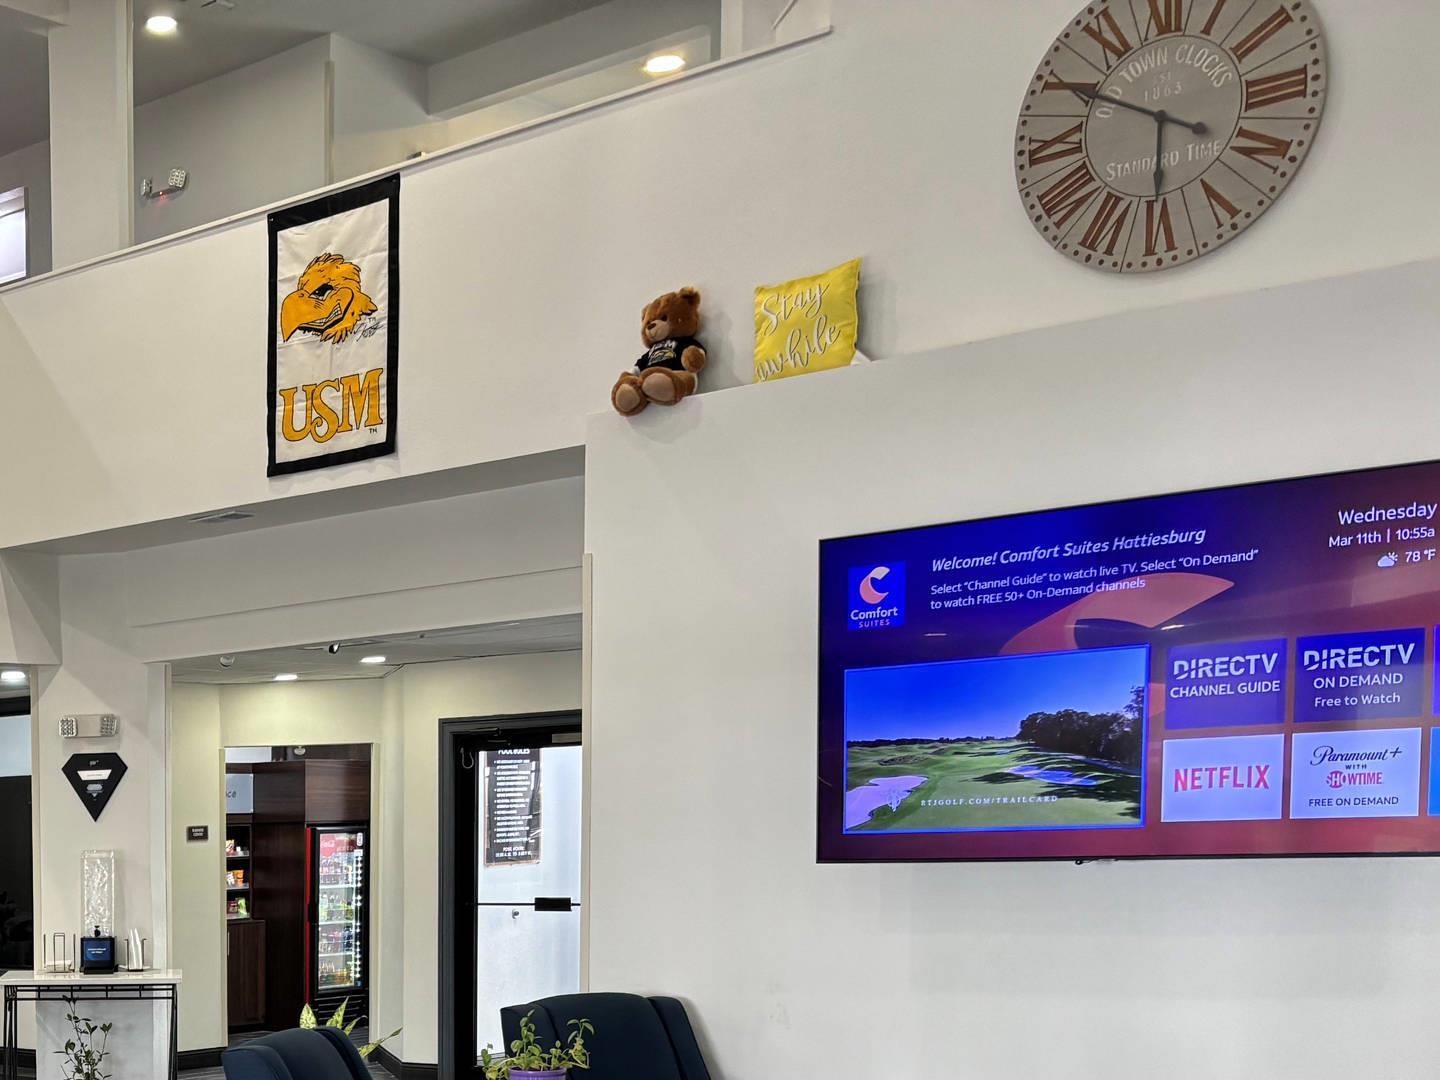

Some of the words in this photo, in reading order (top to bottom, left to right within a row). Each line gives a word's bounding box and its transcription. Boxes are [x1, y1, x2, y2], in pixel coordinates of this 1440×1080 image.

[1119, 46, 1168, 82] TOWN
[1175, 44, 1232, 88] CLOCKS
[1187, 140, 1220, 161] TIME
[761, 281, 830, 336] Stay
[278, 367, 384, 444] USM
[1338, 501, 1438, 525] Wednesday
[1328, 535, 1353, 548] Mar
[1356, 531, 1382, 545] 11th
[1395, 526, 1435, 540] 10:55a
[932, 552, 998, 572] Welcome!
[1000, 544, 1060, 564] Comfort
[1062, 541, 1109, 557] Suites
[1112, 528, 1206, 550] Hattiesburg
[1405, 550, 1421, 563] 78
[931, 583, 962, 595] Select
[1049, 572, 1061, 582] to
[1063, 566, 1097, 581] watch
[1099, 564, 1119, 576] live
[1121, 562, 1138, 574] TV.
[1140, 559, 1176, 572] Select
[930, 599, 942, 610] to
[943, 595, 975, 608] watch
[976, 592, 1003, 605] FREE
[1004, 591, 1025, 602] 50+
[1026, 581, 1094, 599] On-Demand
[1095, 577, 1146, 592] channels
[850, 606, 898, 620] Comfort
[859, 618, 891, 628] SUITES
[1173, 652, 1279, 680] DIRECTV
[1303, 643, 1415, 672] DIRECTV
[1169, 683, 1234, 699] CHANNEL
[1237, 680, 1281, 694] GUIDE
[1313, 676, 1336, 690] ON
[1339, 673, 1404, 688] DEMAND
[1314, 696, 1342, 708] Free
[1344, 695, 1358, 707] to
[1361, 692, 1401, 706] Watch
[1309, 745, 1403, 766] Paramount+
[1173, 764, 1270, 793] NETFLIX
[1326, 770, 1383, 788] SHOWTIME
[1308, 798, 1333, 807] FREE
[1335, 797, 1351, 806] ON
[1353, 796, 1399, 806] DEMAND
